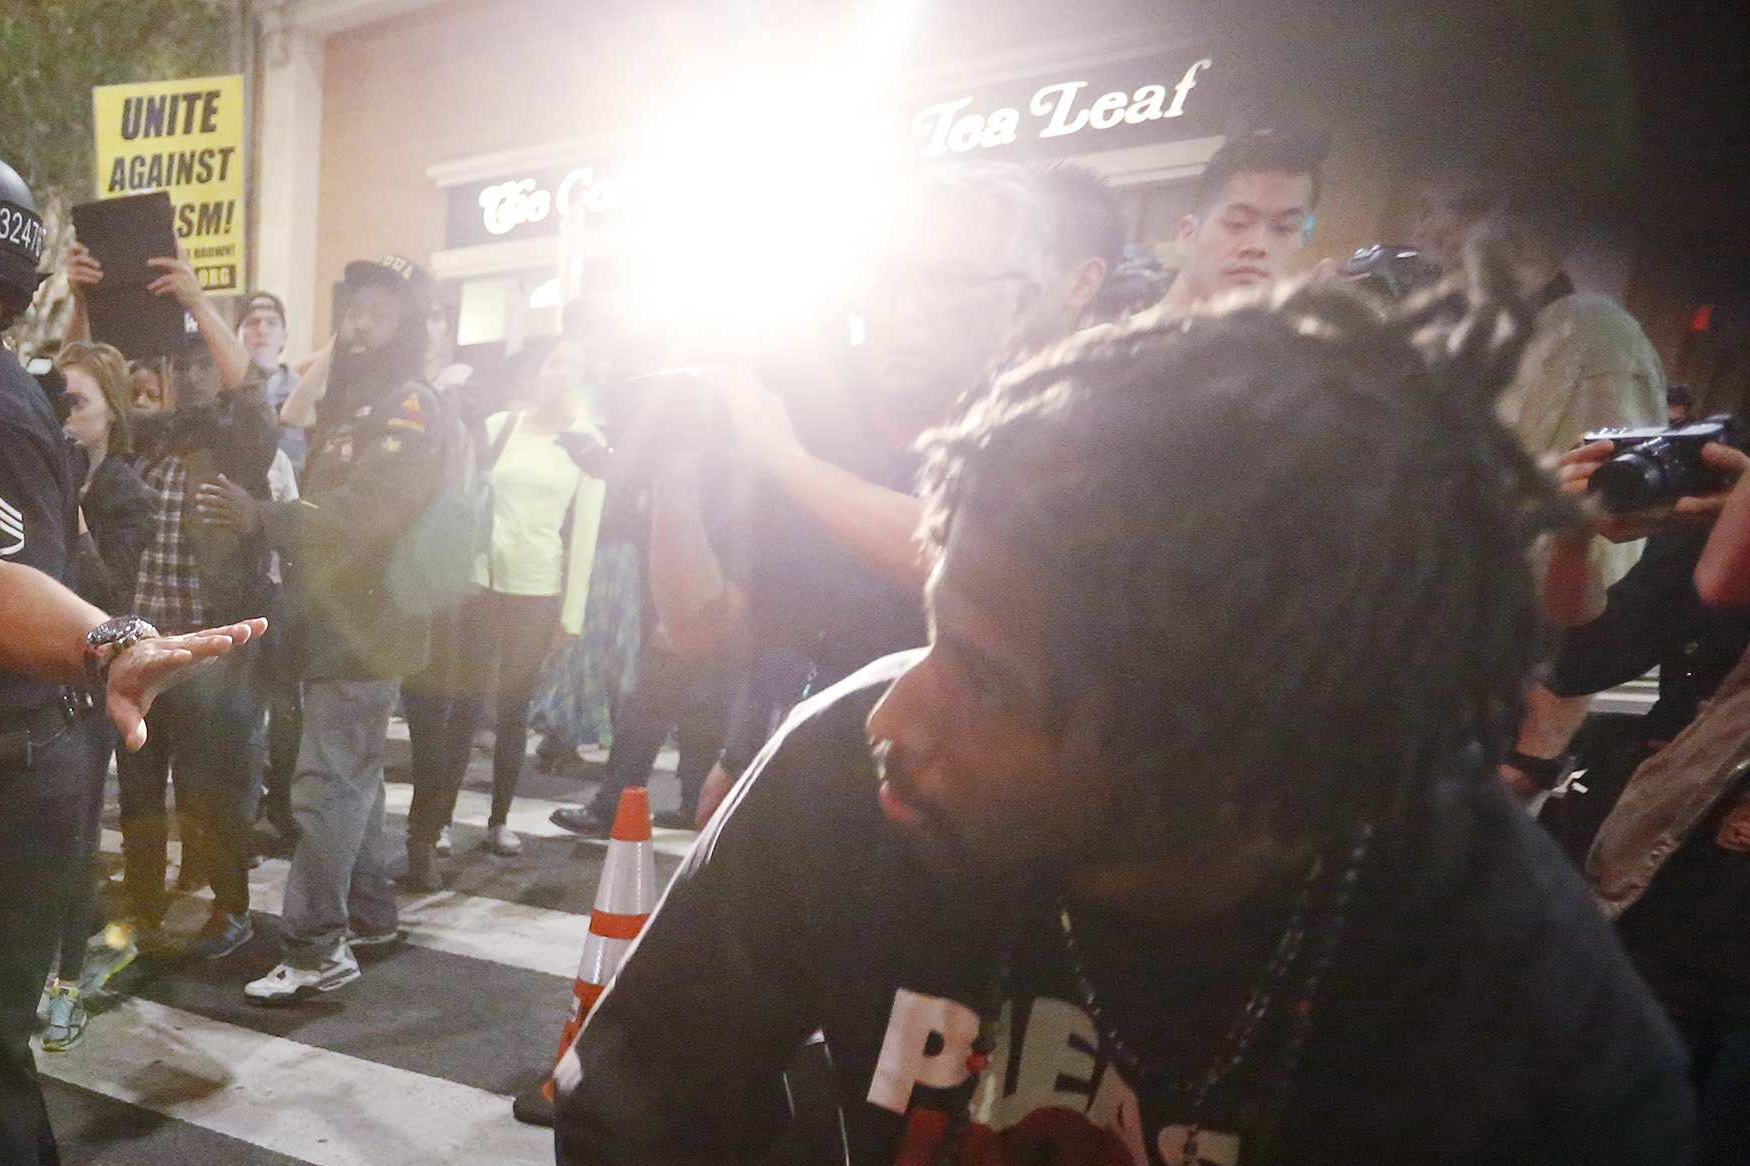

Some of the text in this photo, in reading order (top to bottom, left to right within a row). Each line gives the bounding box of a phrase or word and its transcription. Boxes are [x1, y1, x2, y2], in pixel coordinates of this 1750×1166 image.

[121, 90, 221, 140] UNITE
[912, 96, 1020, 158] Tea
[1029, 59, 1212, 138] Leaf
[108, 147, 235, 192] AGAINST
